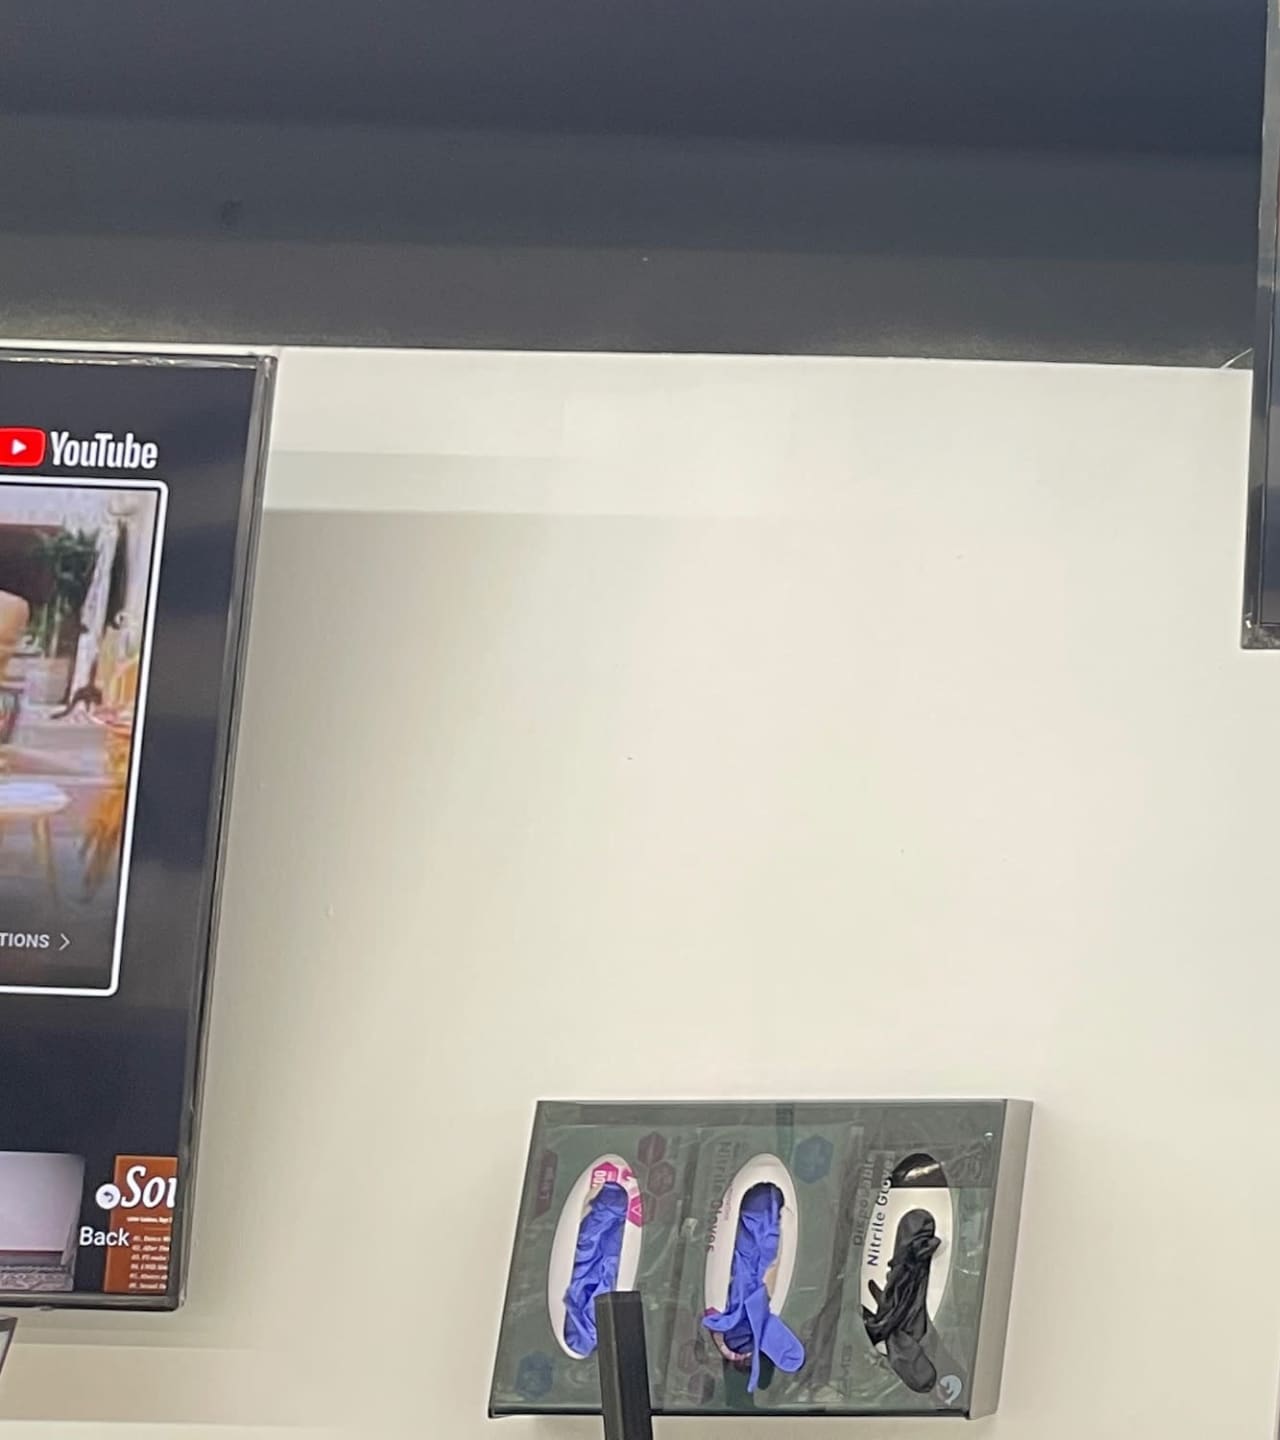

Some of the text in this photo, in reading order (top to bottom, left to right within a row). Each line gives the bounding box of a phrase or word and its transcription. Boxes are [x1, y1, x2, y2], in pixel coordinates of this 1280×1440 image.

[51, 431, 158, 469] YouTube
[79, 1226, 130, 1247] Back
[867, 1211, 886, 1267] Nitrile
